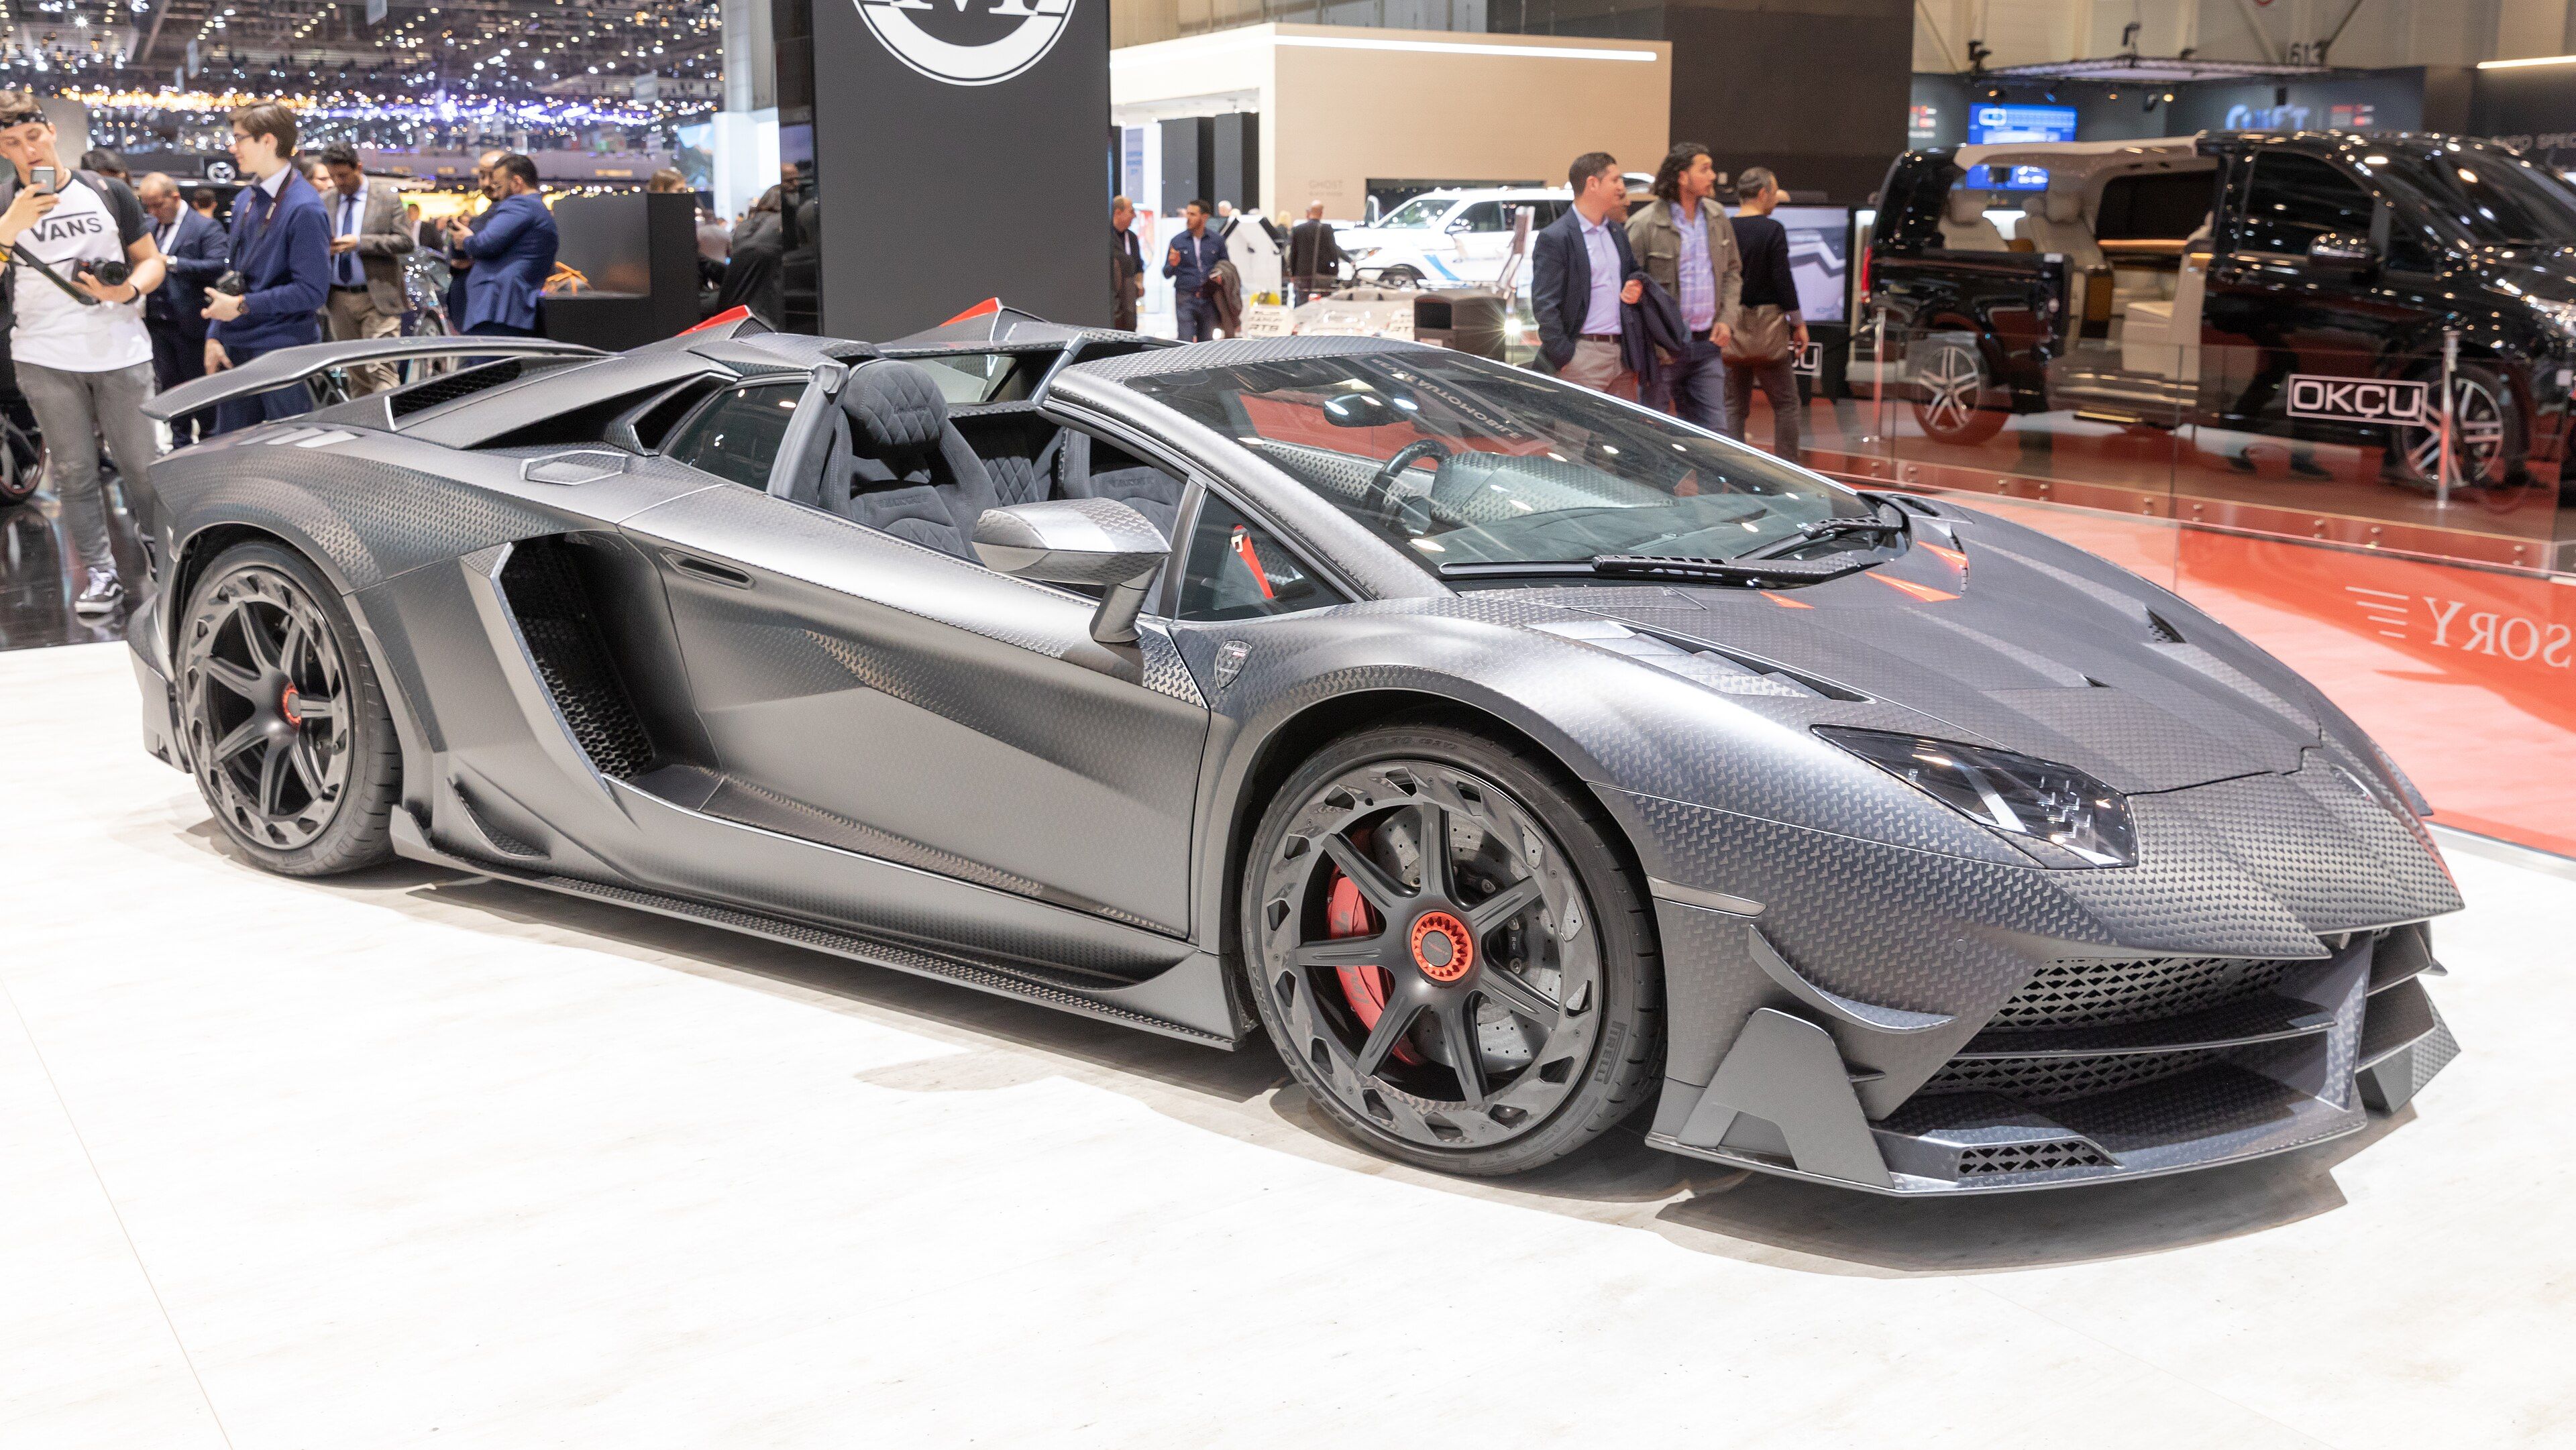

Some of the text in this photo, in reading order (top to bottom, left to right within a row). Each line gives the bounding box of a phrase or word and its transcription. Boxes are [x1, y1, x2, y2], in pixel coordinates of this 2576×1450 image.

[30, 211, 102, 242] VANS
[2293, 380, 2421, 419] OKÇU
[1594, 1020, 1629, 1085] PIRELLI
